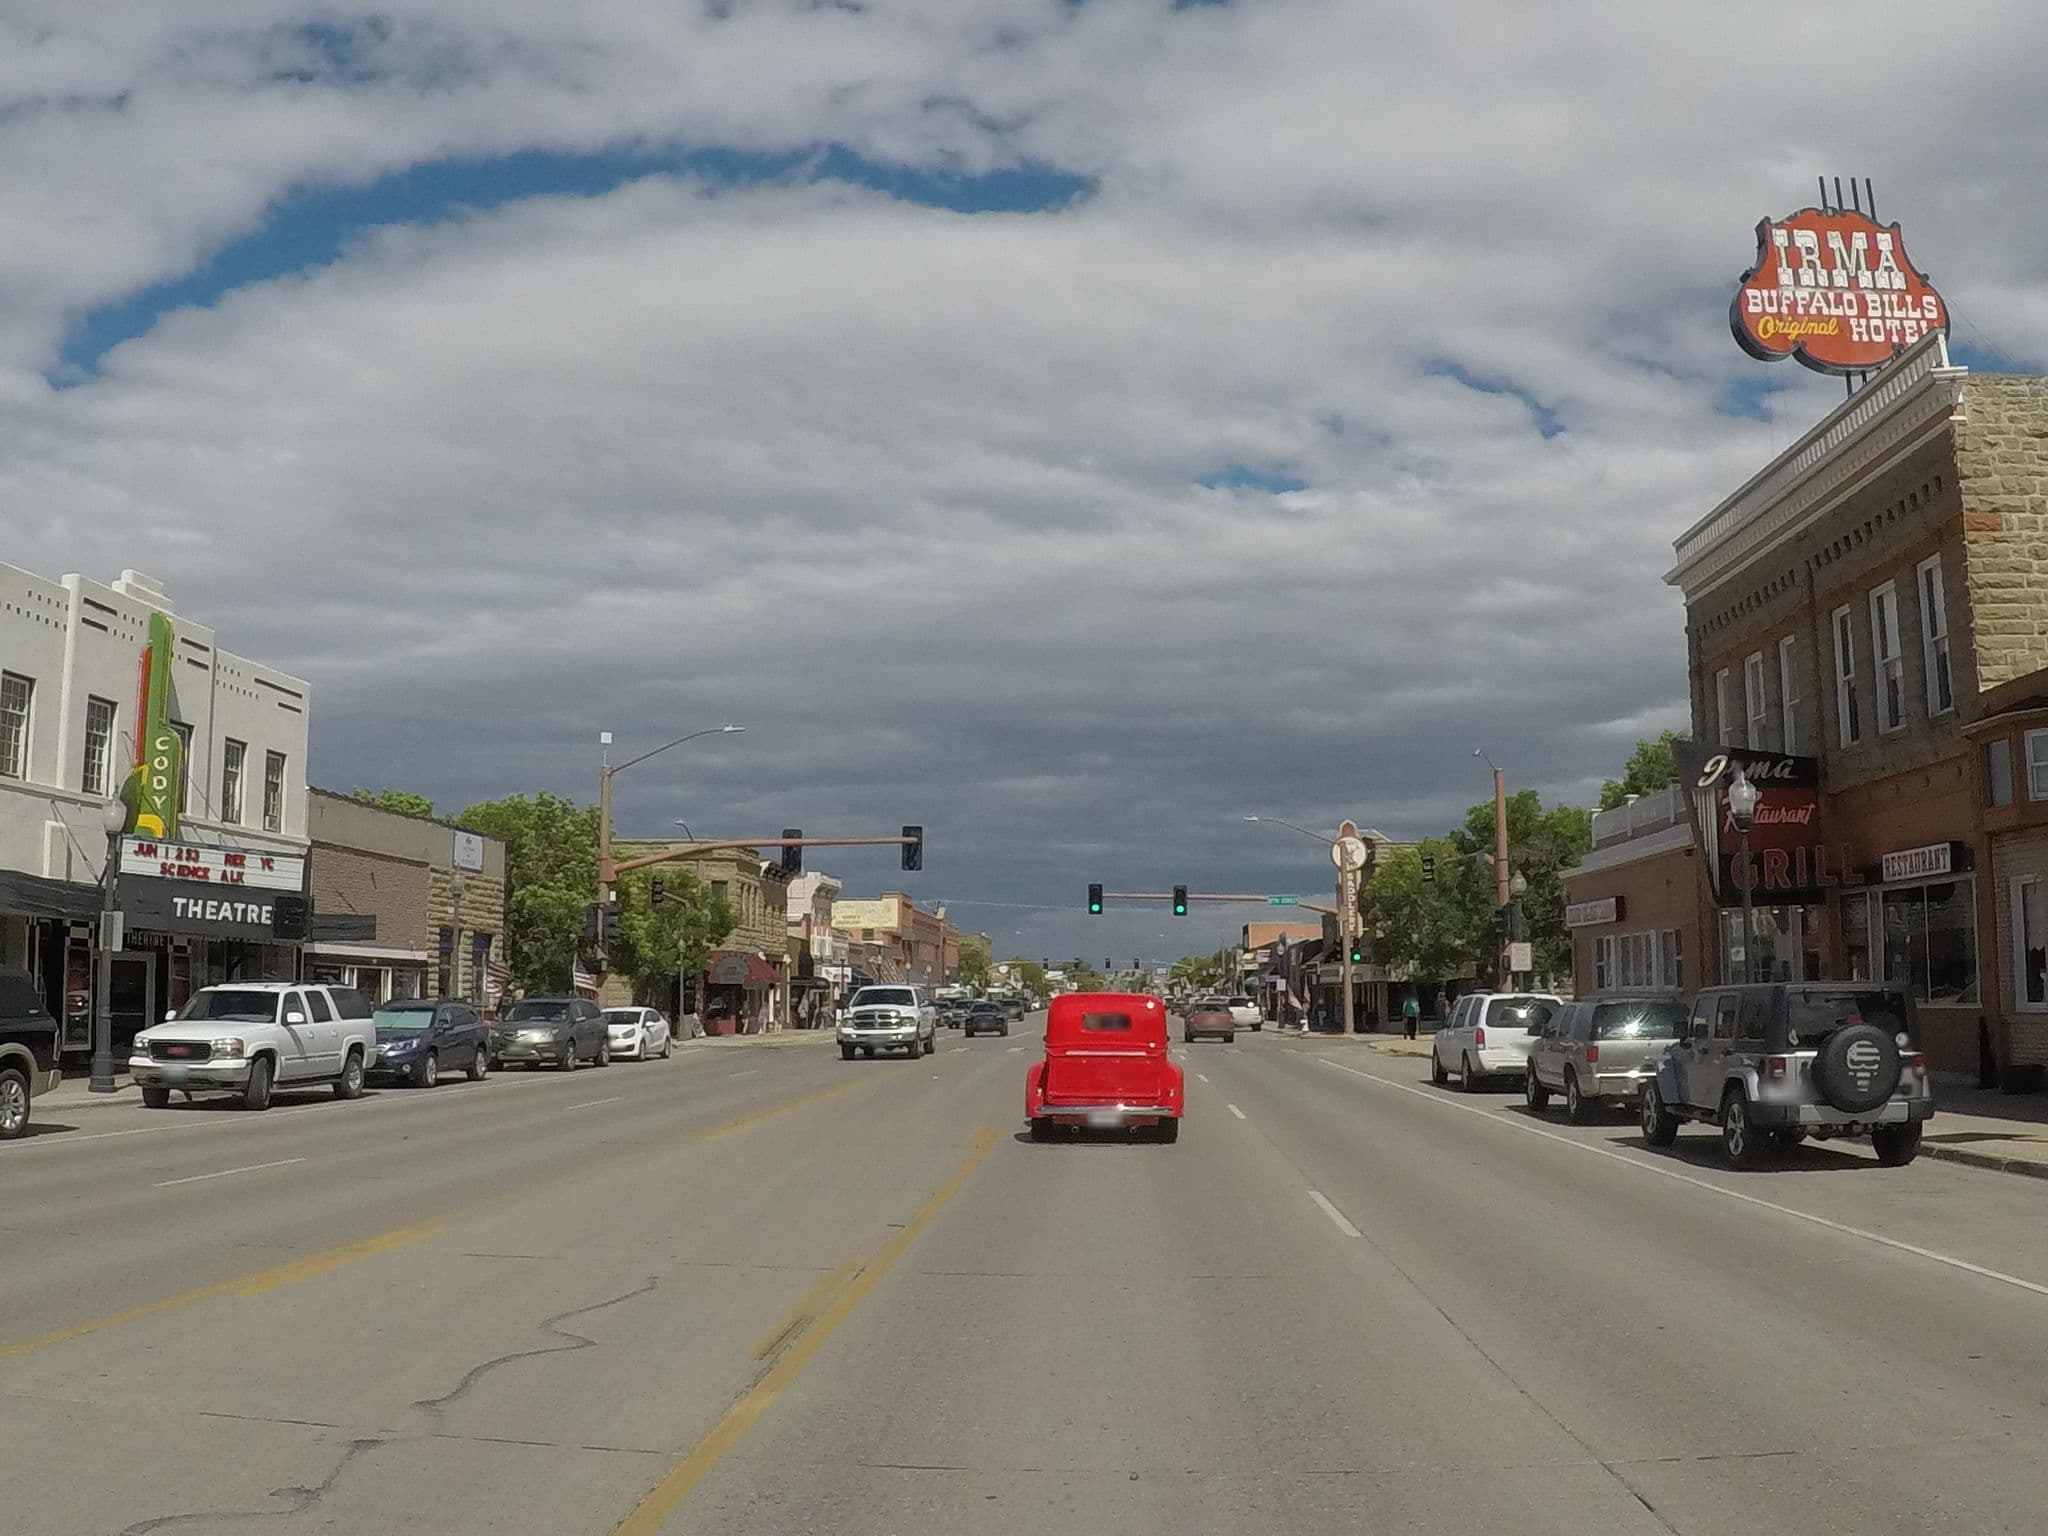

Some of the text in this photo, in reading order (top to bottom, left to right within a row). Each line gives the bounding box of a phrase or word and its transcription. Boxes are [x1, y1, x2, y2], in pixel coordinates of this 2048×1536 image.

[1771, 228, 1907, 290] IRMA
[1745, 288, 1939, 319] BUFFALO BILLS
[1757, 315, 1839, 340] Original
[152, 736, 171, 810] CODY
[1698, 754, 1799, 788] Ima
[133, 843, 158, 858] JUN
[1885, 847, 1948, 877] RESTAURANT
[160, 862, 210, 881] SCIENCE
[1731, 842, 1865, 890] GRILL
[173, 897, 273, 925] THEATRE
